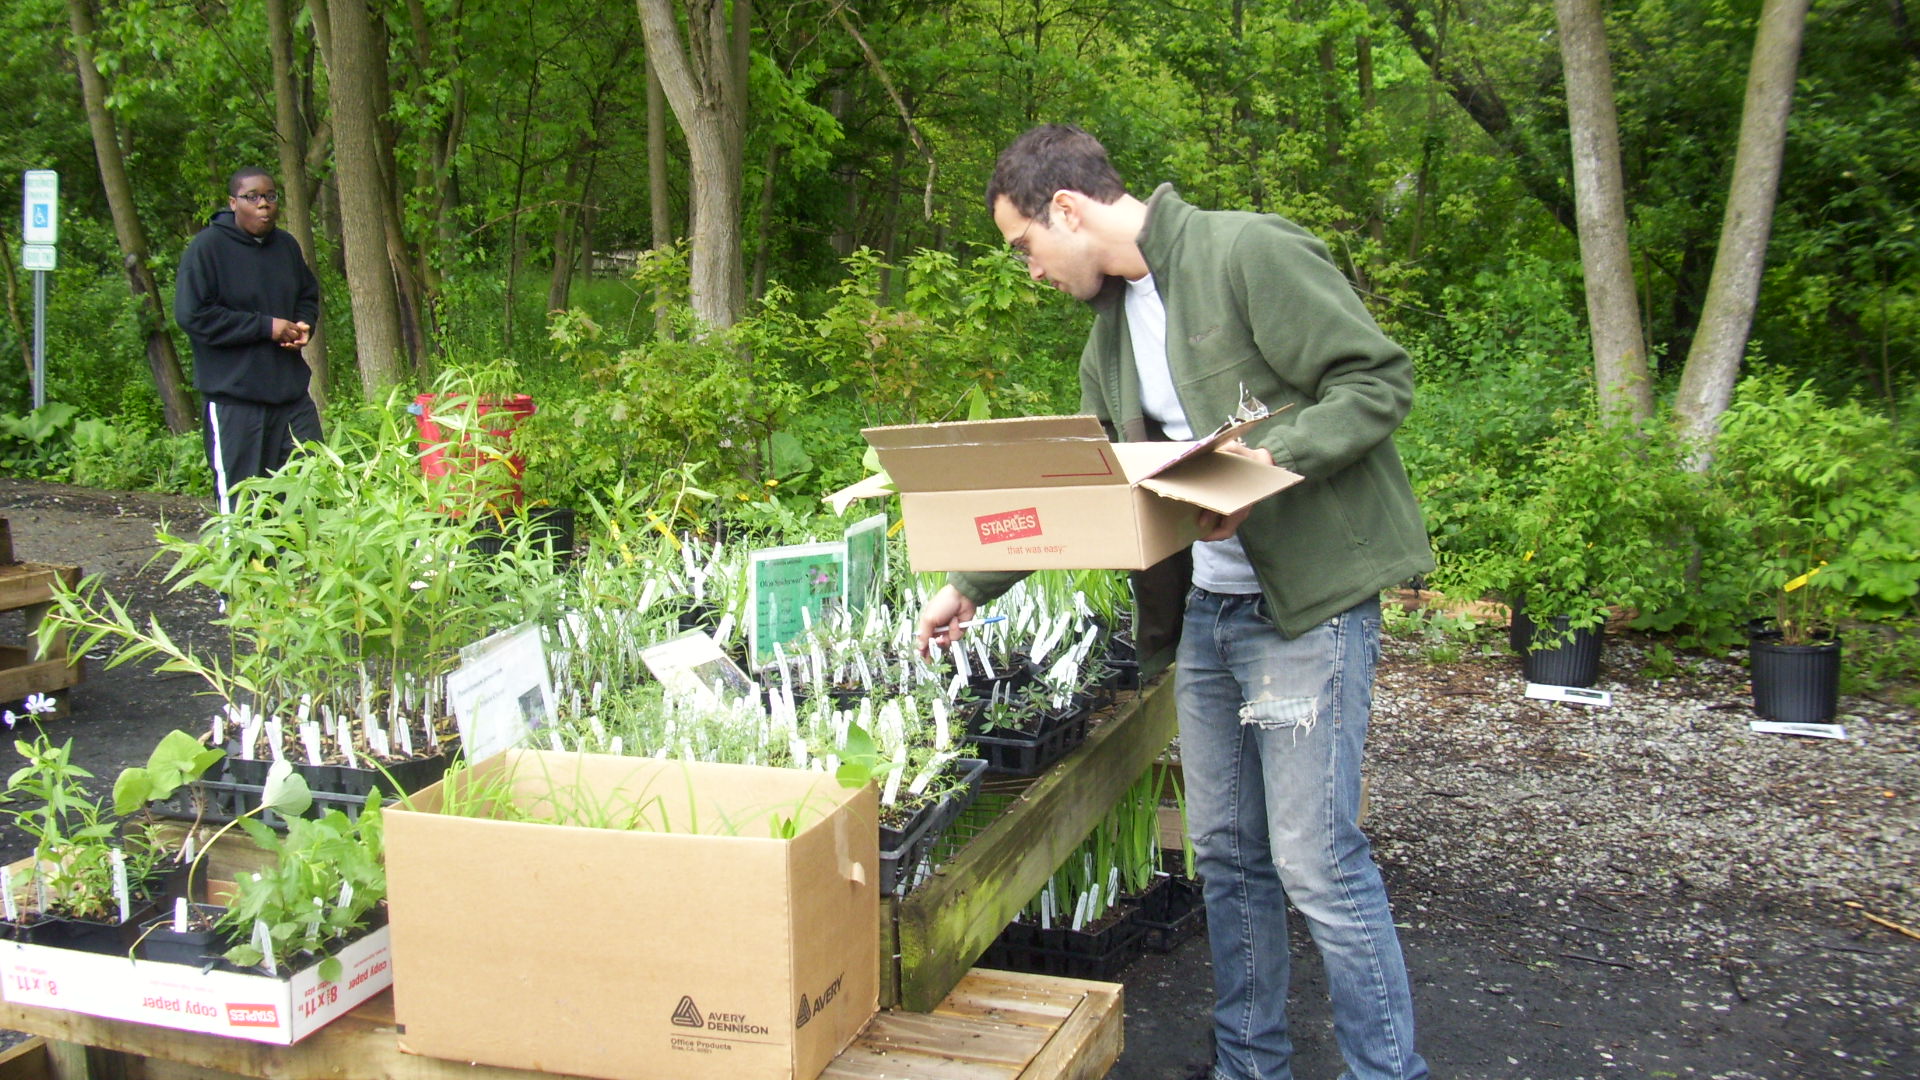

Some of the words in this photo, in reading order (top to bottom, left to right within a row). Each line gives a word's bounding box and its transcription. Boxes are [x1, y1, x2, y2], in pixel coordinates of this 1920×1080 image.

[980, 514, 1036, 536] STAPLES
[1007, 545, 1023, 555] that
[1026, 546, 1042, 554] was
[370, 961, 387, 976] copy
[348, 969, 368, 990] paper
[812, 974, 843, 1017] AVERY
[143, 996, 180, 1012] paper
[185, 1000, 217, 1017] copy
[228, 1009, 276, 1022] STAPLES
[708, 1012, 746, 1023] AVERY
[707, 1021, 769, 1035] DENNISON
[671, 1038, 694, 1047] Office
[696, 1040, 732, 1051] Products
